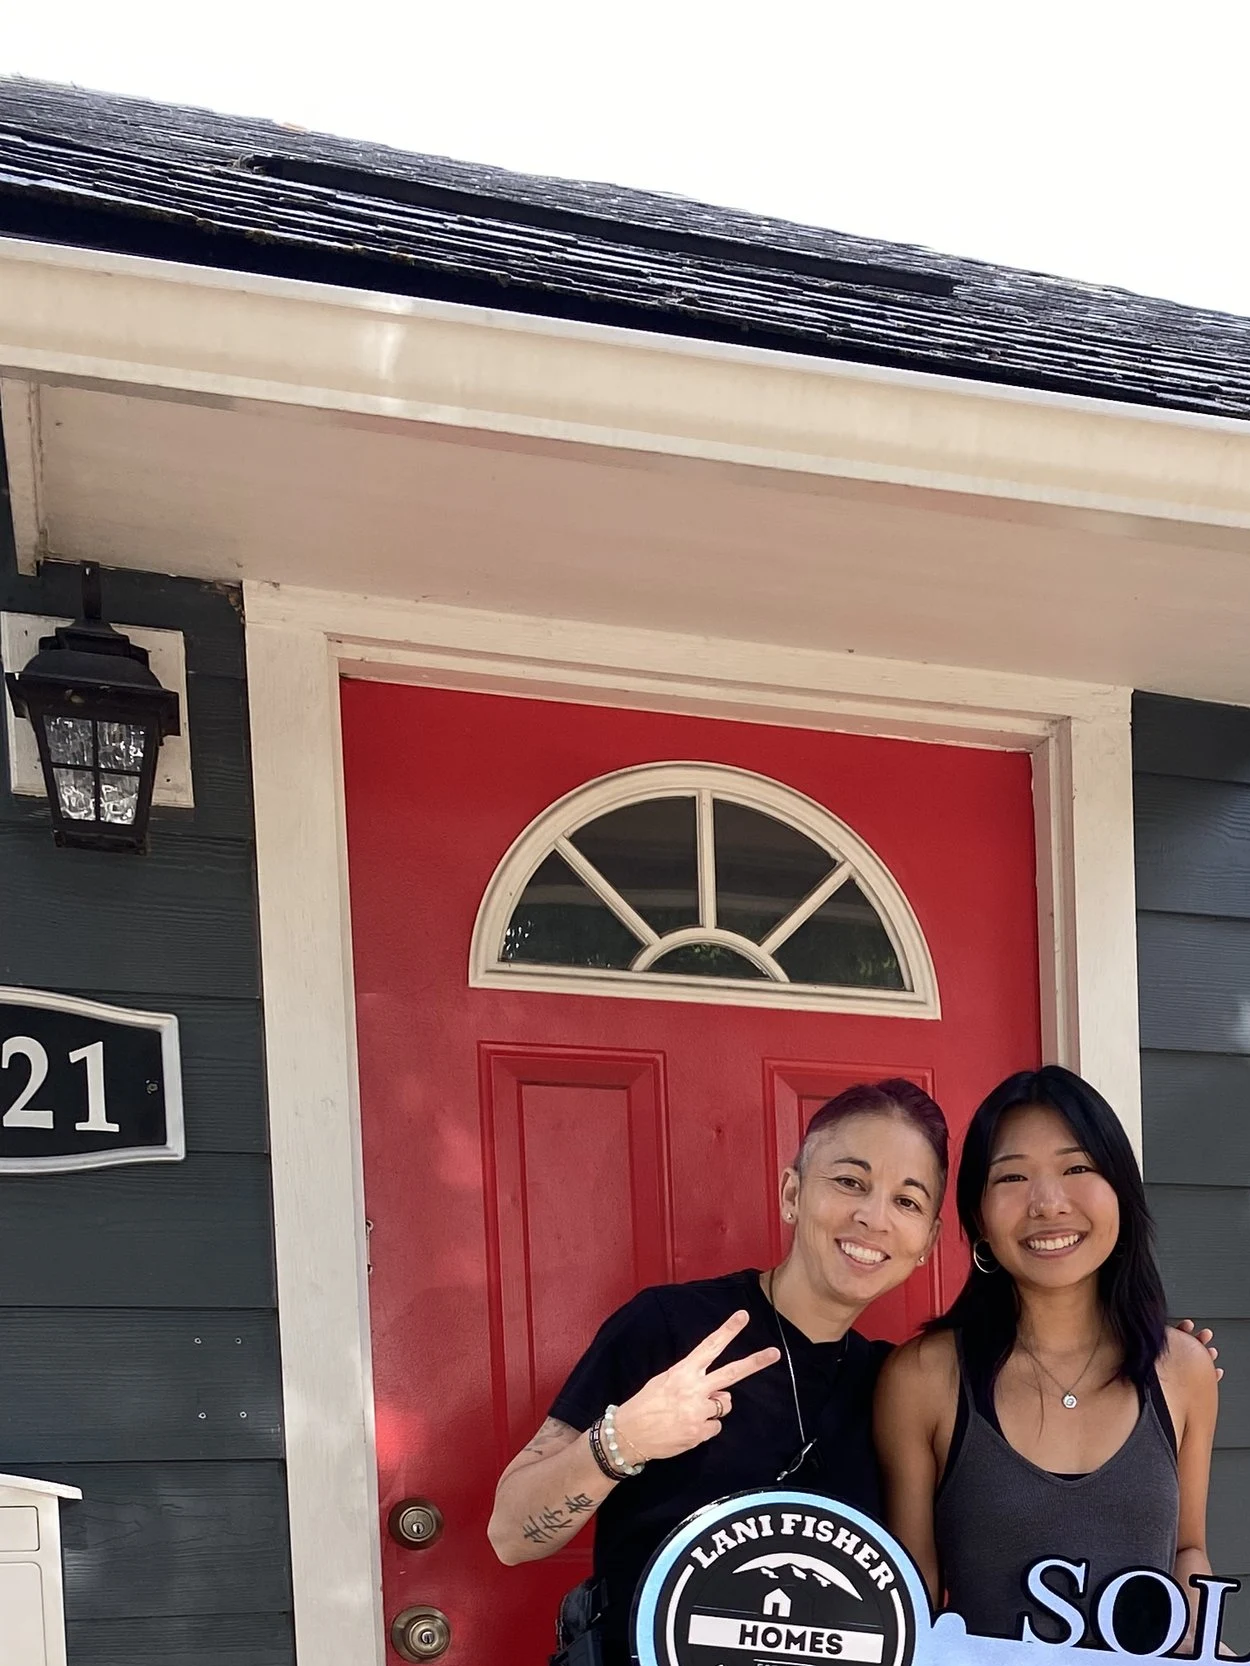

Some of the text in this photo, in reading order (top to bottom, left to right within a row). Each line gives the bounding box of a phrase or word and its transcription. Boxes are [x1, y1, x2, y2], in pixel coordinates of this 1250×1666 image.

[1, 1035, 120, 1133] 21
[522, 1492, 595, 1544] 生存者
[690, 1512, 896, 1592] LANI FISHER
[738, 1623, 844, 1656] HOMES
